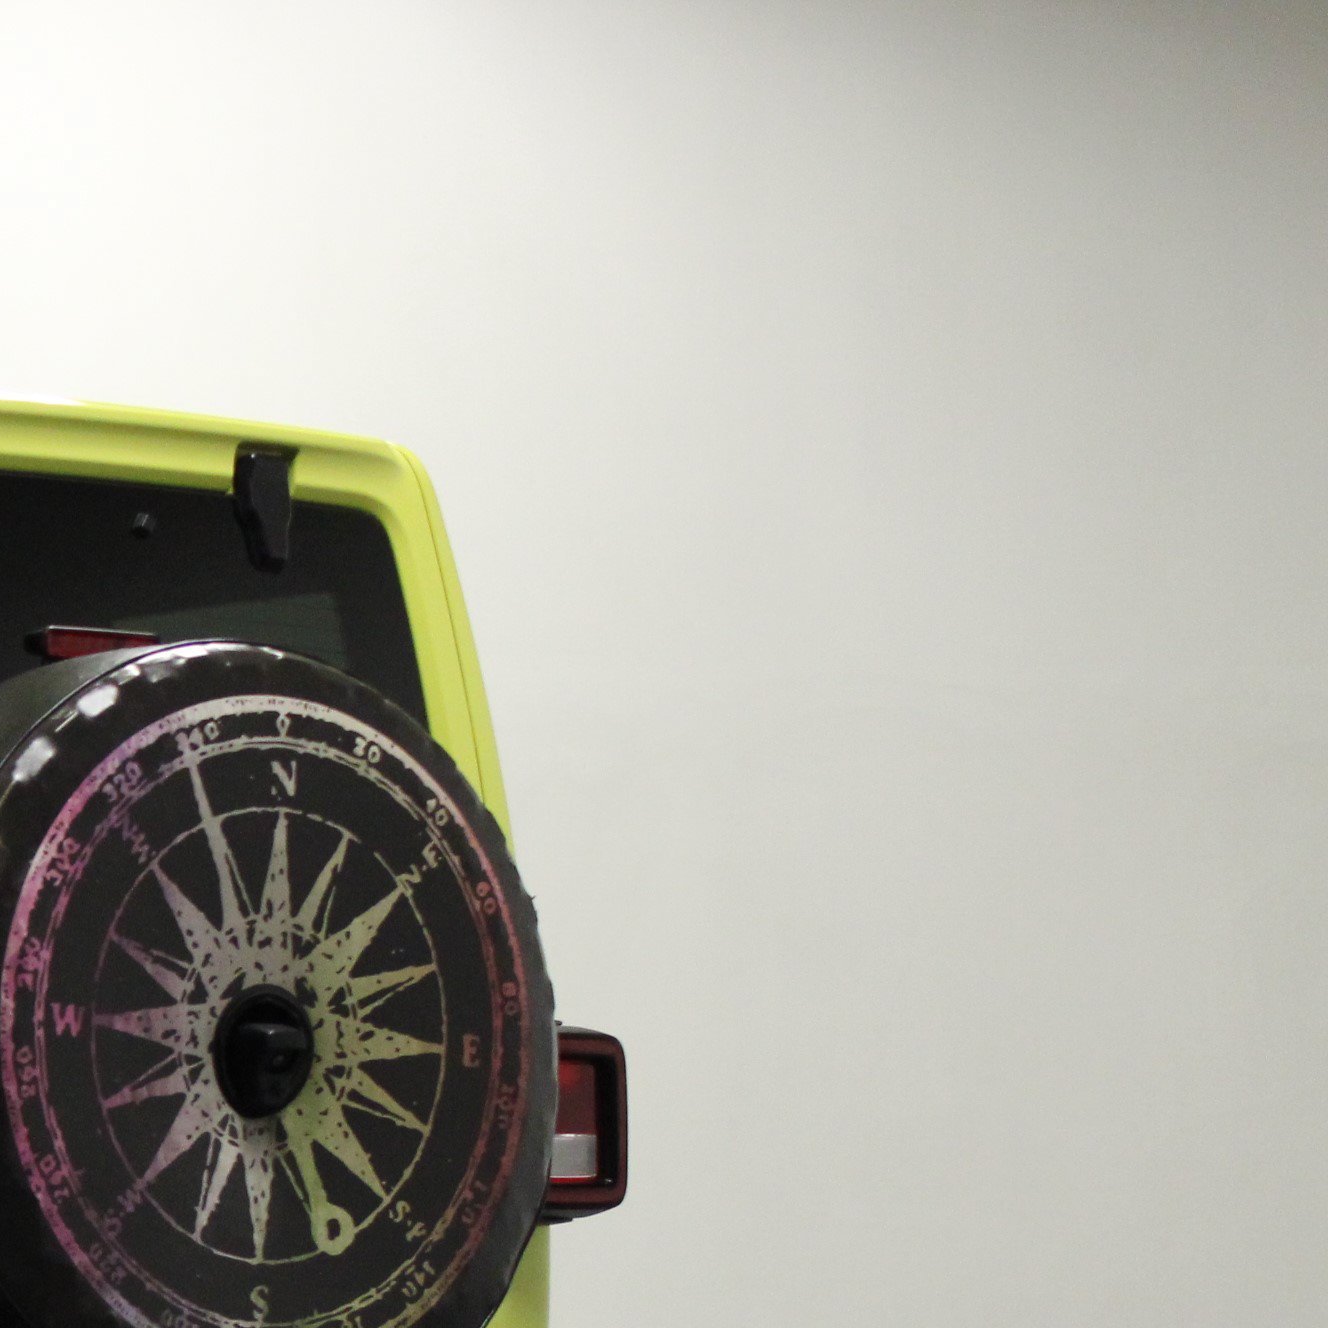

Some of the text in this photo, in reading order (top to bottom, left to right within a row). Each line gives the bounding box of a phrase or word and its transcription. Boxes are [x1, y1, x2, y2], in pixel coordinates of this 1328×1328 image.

[271, 760, 297, 798] N
[51, 1002, 85, 1037] W
[462, 1033, 481, 1068] E
[250, 1285, 269, 1324] S
